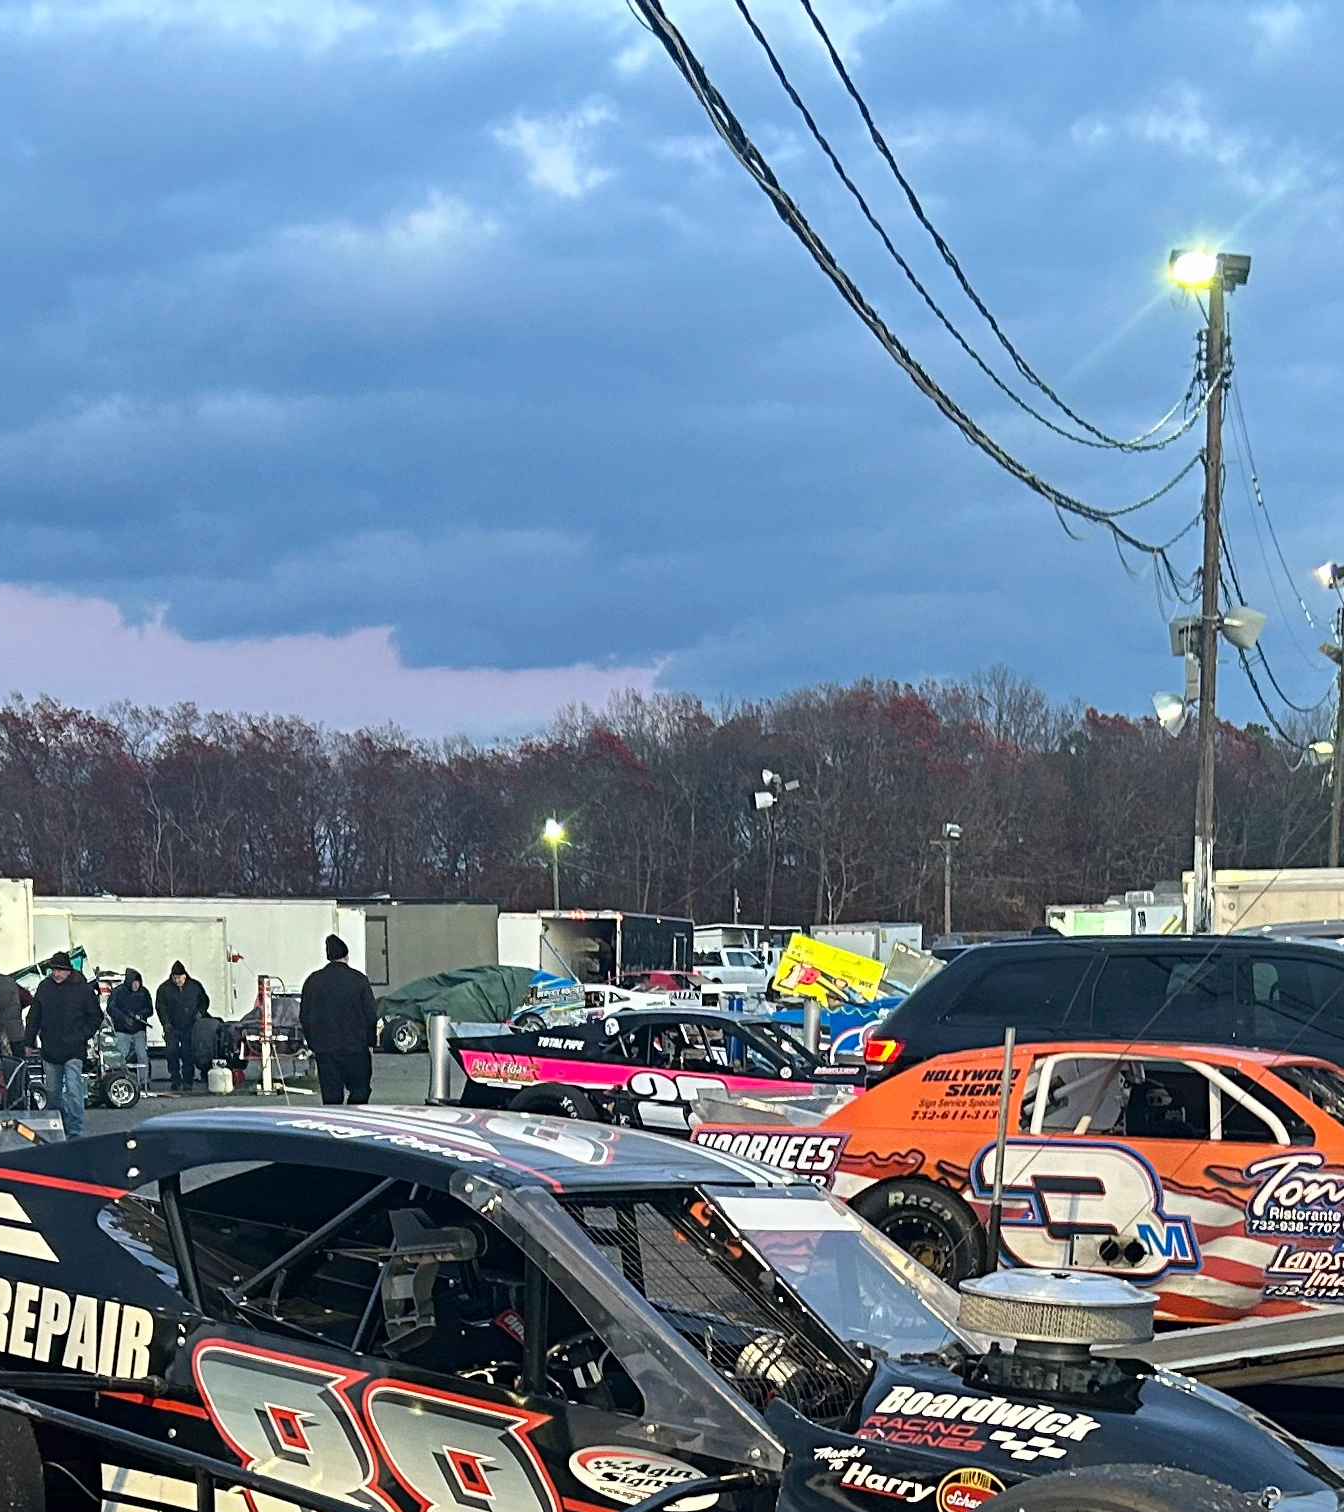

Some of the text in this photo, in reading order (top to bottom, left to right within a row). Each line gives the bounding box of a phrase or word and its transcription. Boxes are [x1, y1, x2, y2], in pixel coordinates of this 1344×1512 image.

[888, 1190, 953, 1222] RACER
[1269, 1206, 1342, 1222] Ristorante
[862, 1415, 979, 1438] RACING
[874, 1385, 1103, 1441] Boardwick
[628, 1462, 693, 1480] Agin
[841, 1462, 937, 1503] Harry
